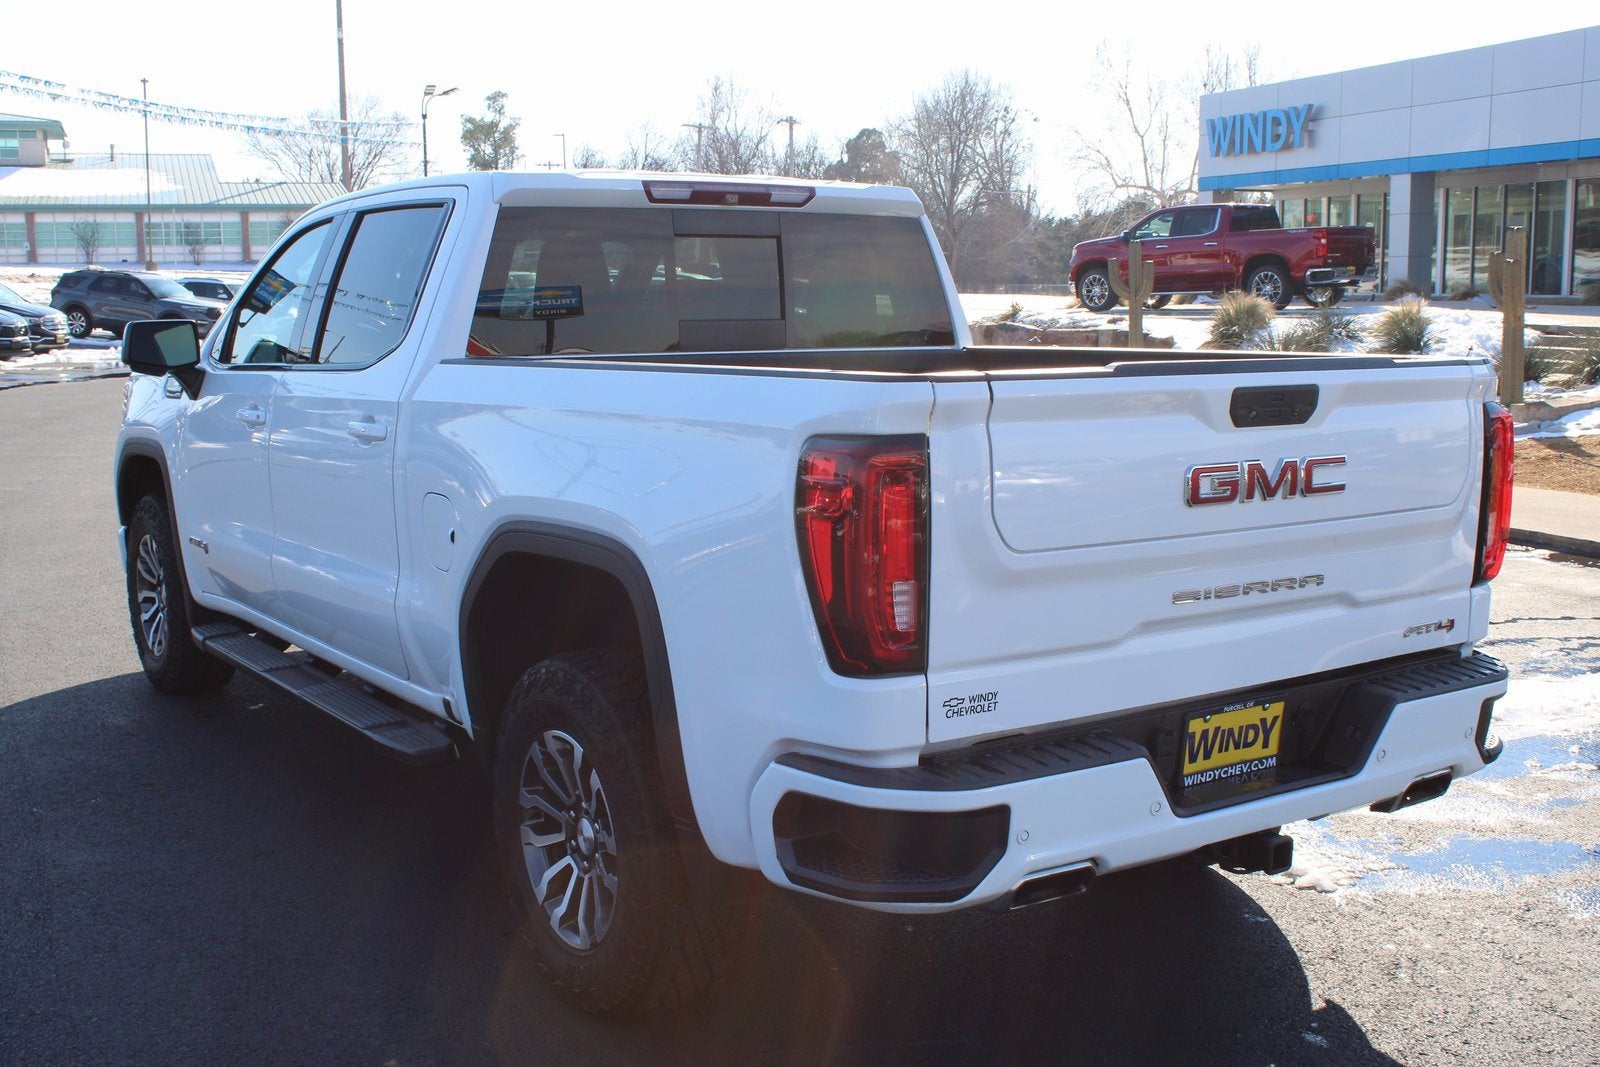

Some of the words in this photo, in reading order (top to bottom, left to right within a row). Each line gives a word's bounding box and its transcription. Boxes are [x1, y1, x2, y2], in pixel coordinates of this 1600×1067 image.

[1206, 103, 1314, 158] WINDY
[1184, 453, 1348, 508] GMC
[1172, 574, 1325, 605] SIERRA
[1402, 617, 1455, 639] AT4
[945, 701, 999, 719] CHEVROLET
[968, 690, 999, 705] WINDY
[1186, 714, 1281, 765] WINDY
[1183, 756, 1277, 787] WINDYCHEV.COM
